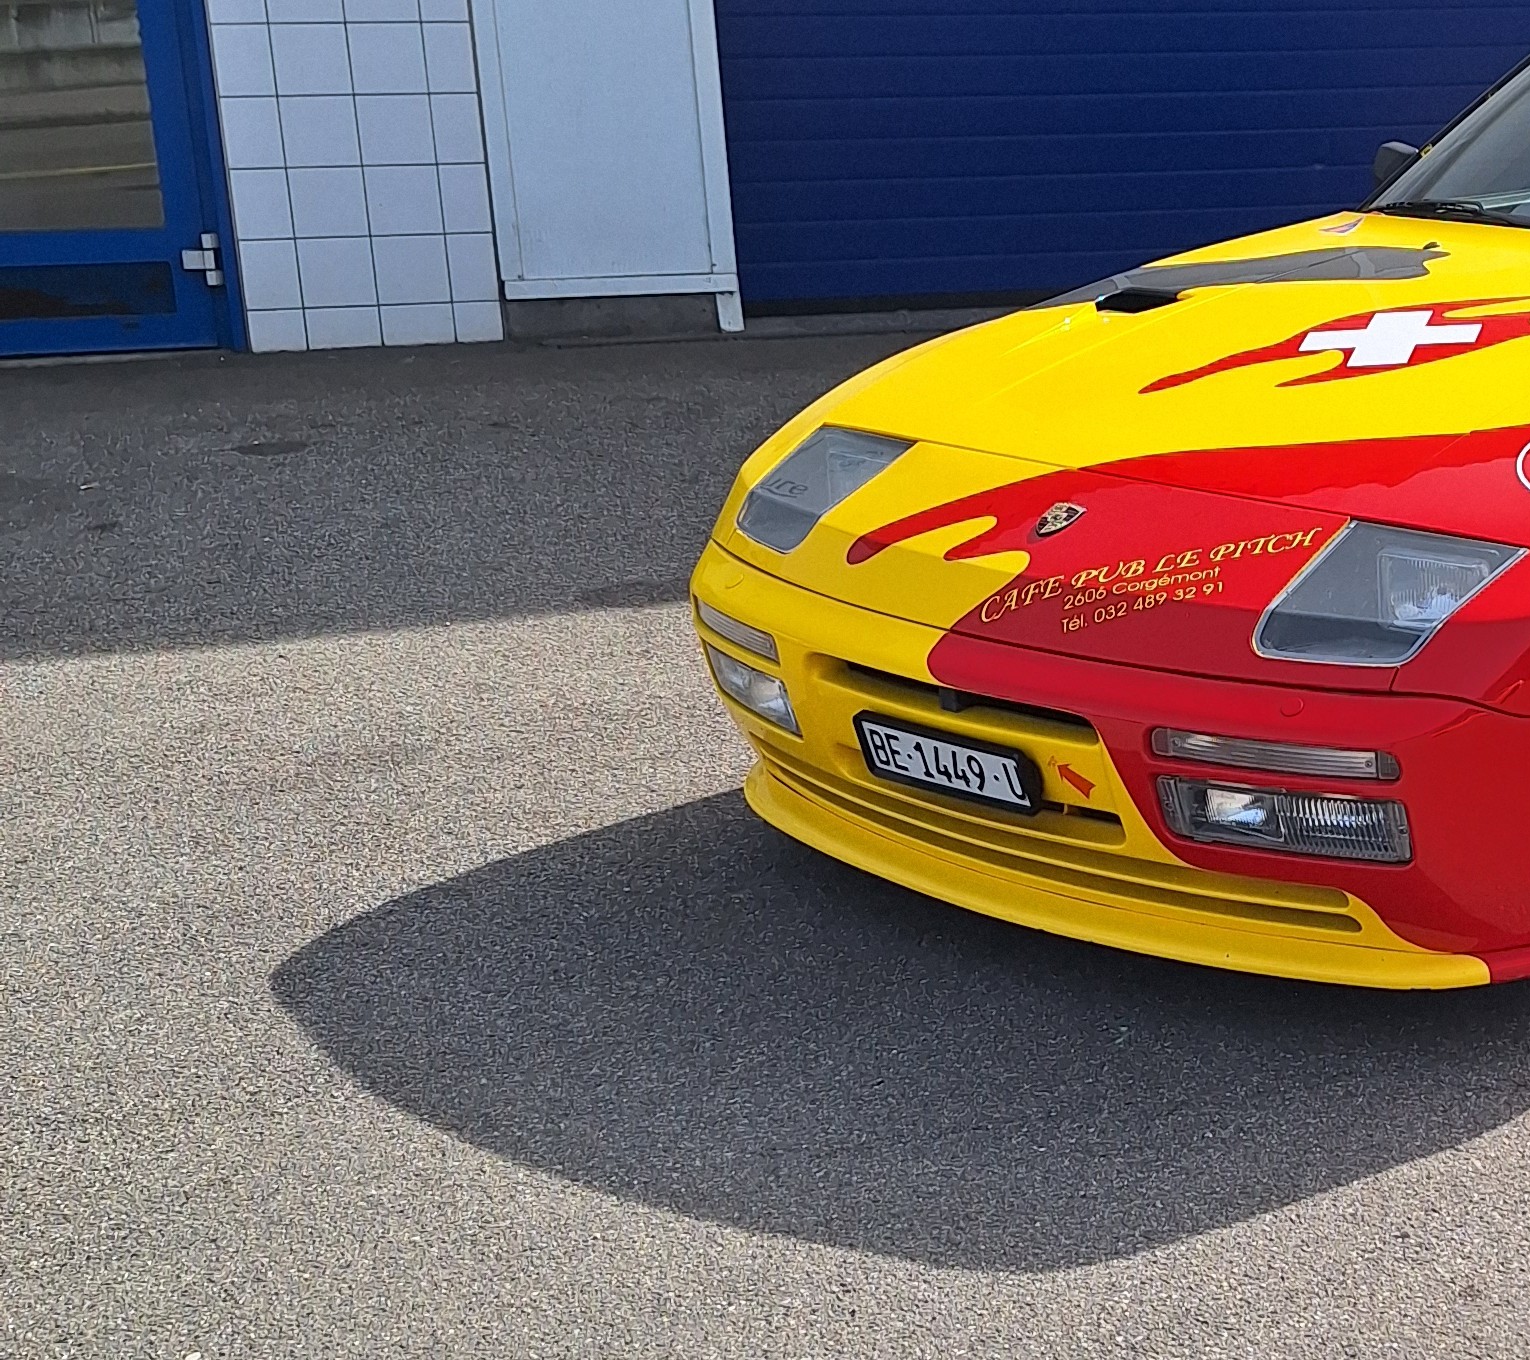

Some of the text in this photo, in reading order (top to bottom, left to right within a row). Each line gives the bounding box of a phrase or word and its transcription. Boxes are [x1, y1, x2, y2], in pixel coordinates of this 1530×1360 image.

[981, 527, 1323, 623] CAFE PUB LE PITCH
[1062, 565, 1221, 611] 2606 Corgémont
[1061, 581, 1224, 634] Tél. 032 489 32 91
